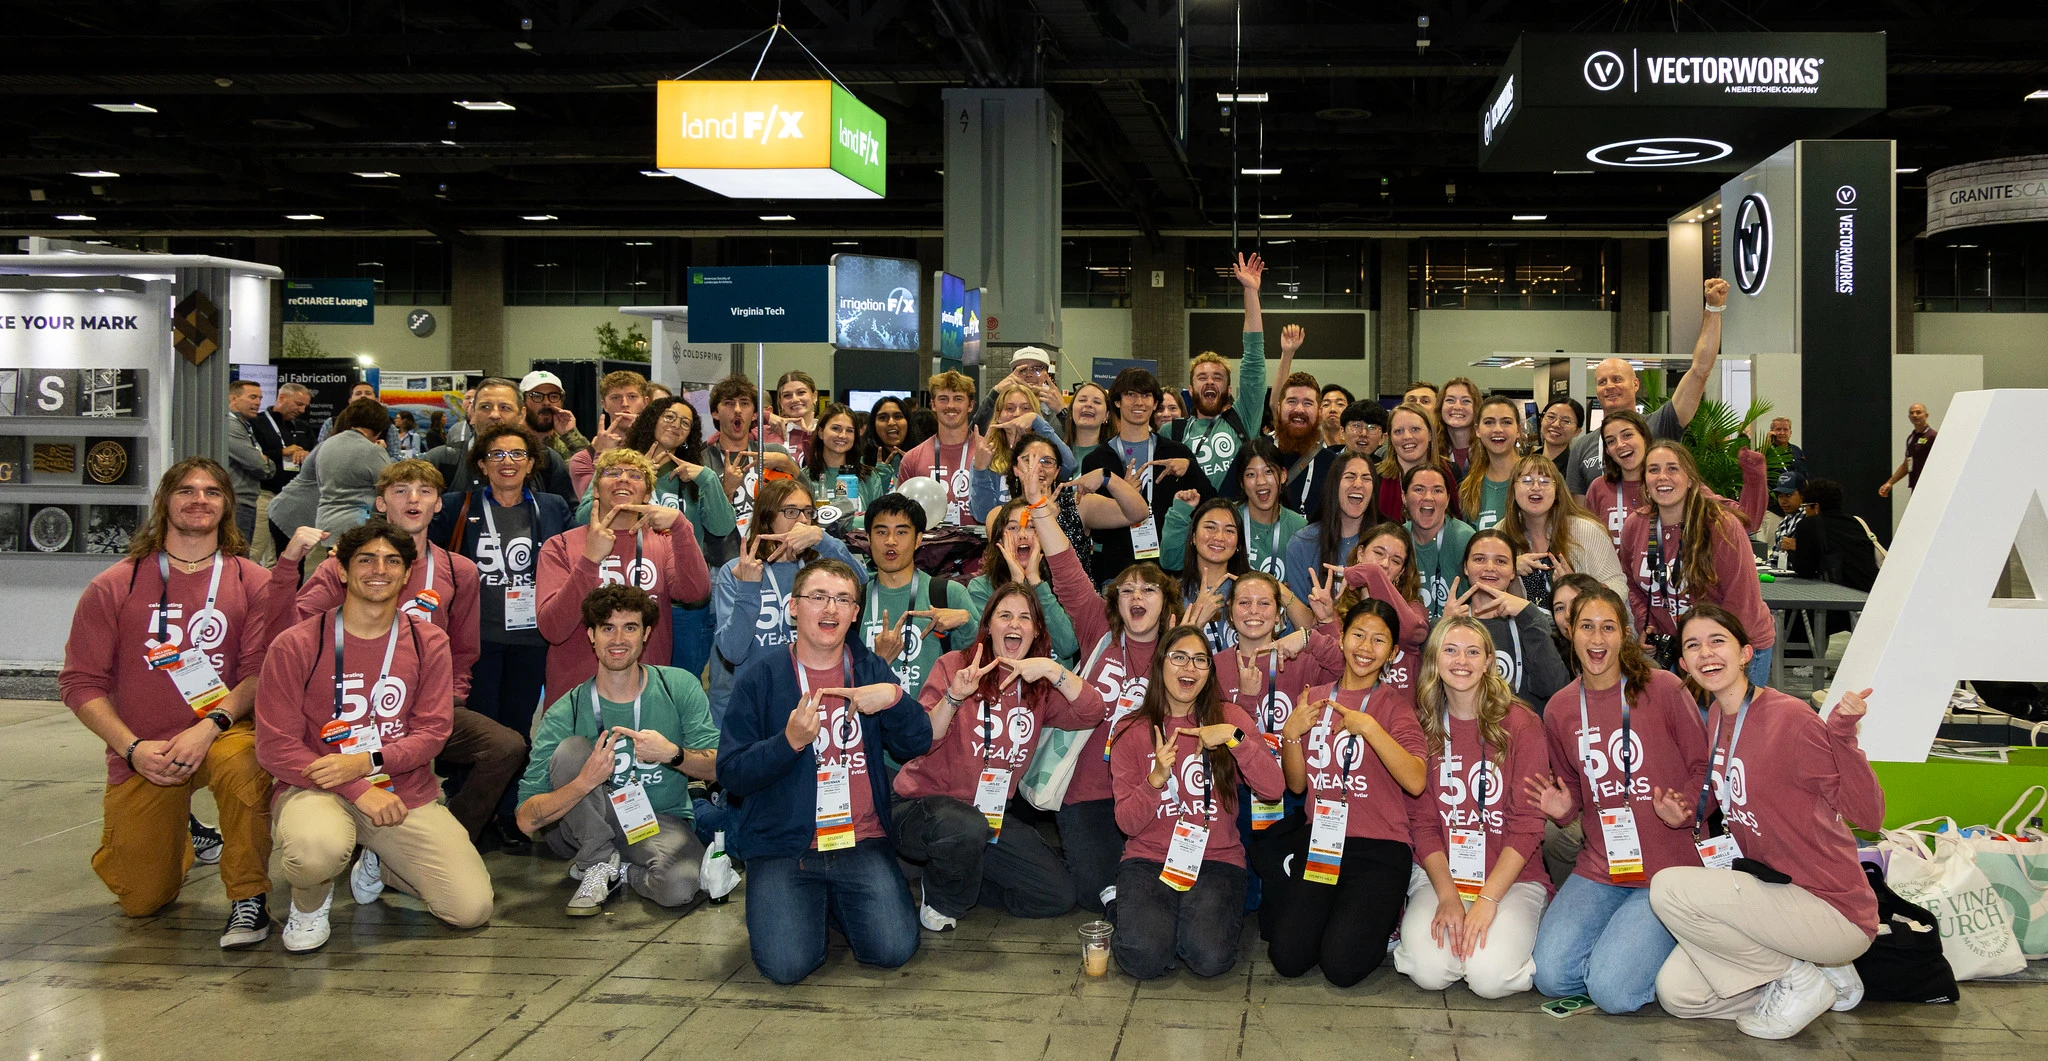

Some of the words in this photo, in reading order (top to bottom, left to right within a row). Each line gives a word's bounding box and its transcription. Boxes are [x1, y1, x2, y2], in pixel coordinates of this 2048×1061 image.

[1647, 57, 1820, 85] VECTORWORKS
[1732, 86, 1782, 94] NEMETSCHEK
[1782, 86, 1819, 94] COMPANY
[682, 111, 737, 139] land
[743, 104, 804, 145] F/X
[959, 108, 969, 121] A
[959, 121, 969, 133] 7
[839, 118, 859, 154] land
[859, 130, 879, 165] F/X
[1839, 214, 1854, 294] VECTORWORKS
[288, 297, 334, 306] reCHARGE
[335, 297, 368, 307] Lounge
[730, 306, 764, 318] Virginia
[764, 306, 785, 316] Tech
[840, 296, 886, 313] irrigation
[887, 295, 915, 316] F/X
[21, 316, 75, 330] YOUR
[81, 316, 138, 330] MARK
[987, 332, 1000, 340] DC
[682, 349, 722, 362] COLDSPRING
[290, 373, 347, 383] Fabrication
[331, 676, 408, 722] 50
[1306, 726, 1365, 771] 50
[1578, 728, 1644, 780] 50
[1307, 772, 1368, 791] YEARS
[1438, 760, 1504, 806] 50
[1156, 798, 1218, 819] YEARS
[1440, 808, 1504, 827] YEARS
[1946, 886, 1997, 915] VINE
[1963, 936, 1986, 957] MAKE
